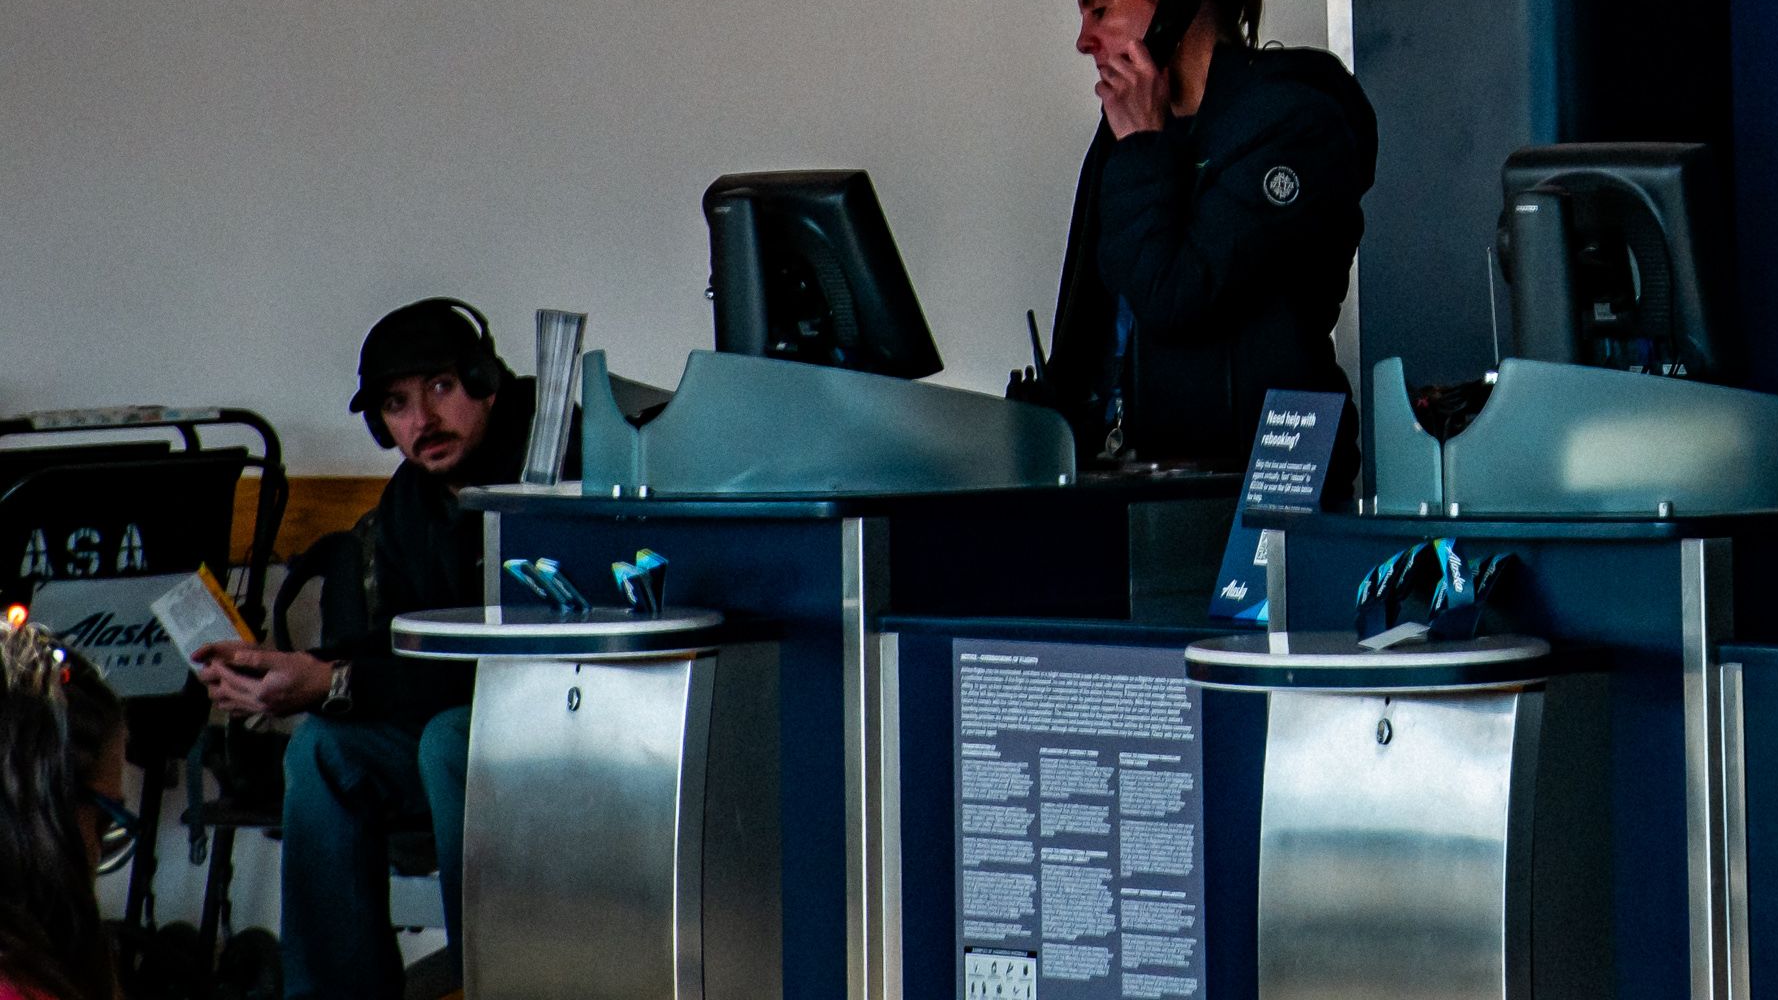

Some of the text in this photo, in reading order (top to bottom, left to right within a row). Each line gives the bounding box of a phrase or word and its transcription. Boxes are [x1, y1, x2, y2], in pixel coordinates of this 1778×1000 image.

[1266, 410, 1287, 426] Need
[1285, 410, 1301, 429] help
[1261, 431, 1301, 452] rebooking?
[19, 522, 149, 577] ASA
[1446, 546, 1466, 593] Alaska
